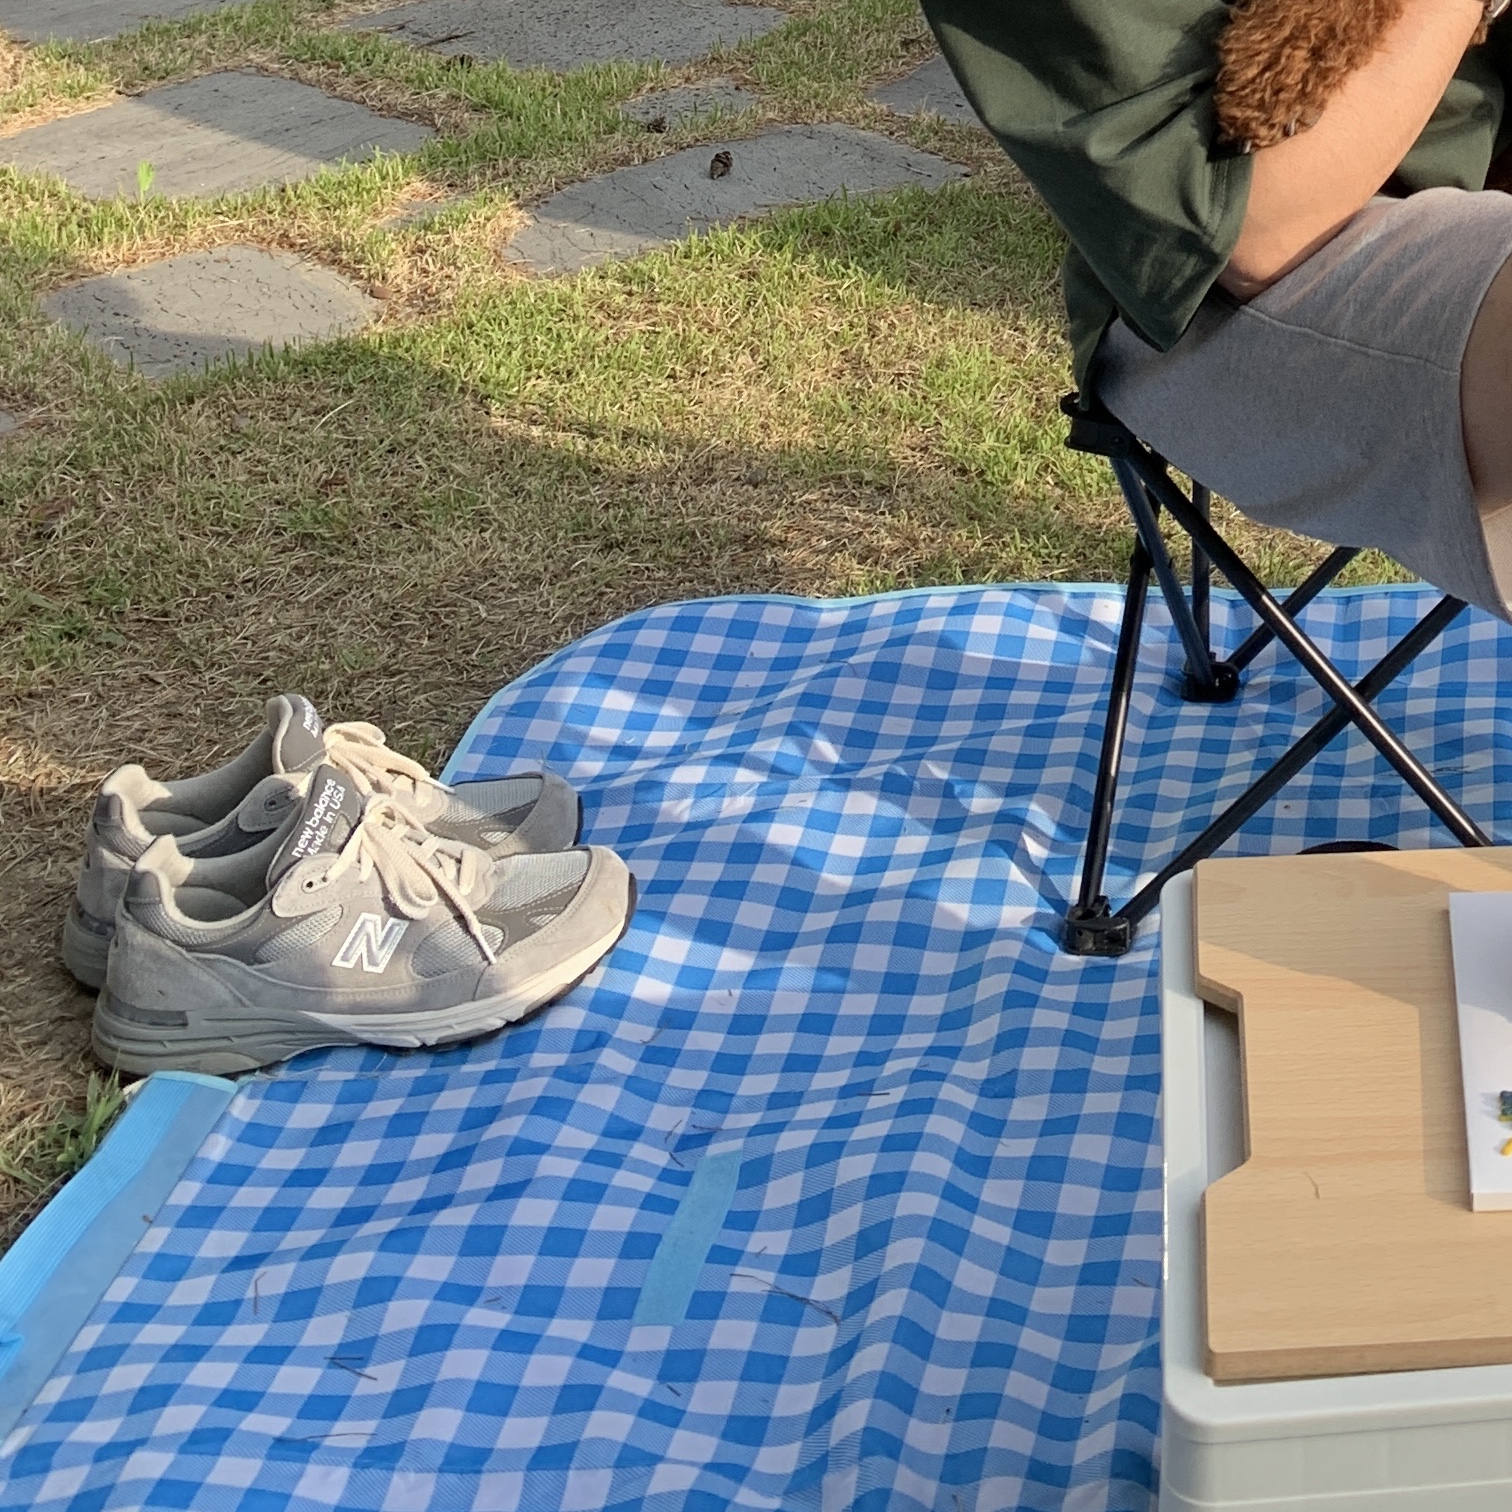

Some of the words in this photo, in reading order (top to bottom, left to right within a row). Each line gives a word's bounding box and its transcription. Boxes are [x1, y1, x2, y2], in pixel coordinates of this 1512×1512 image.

[291, 826, 314, 857] new
[305, 778, 336, 827] balance
[329, 785, 346, 810] USA
[331, 912, 410, 974] N
